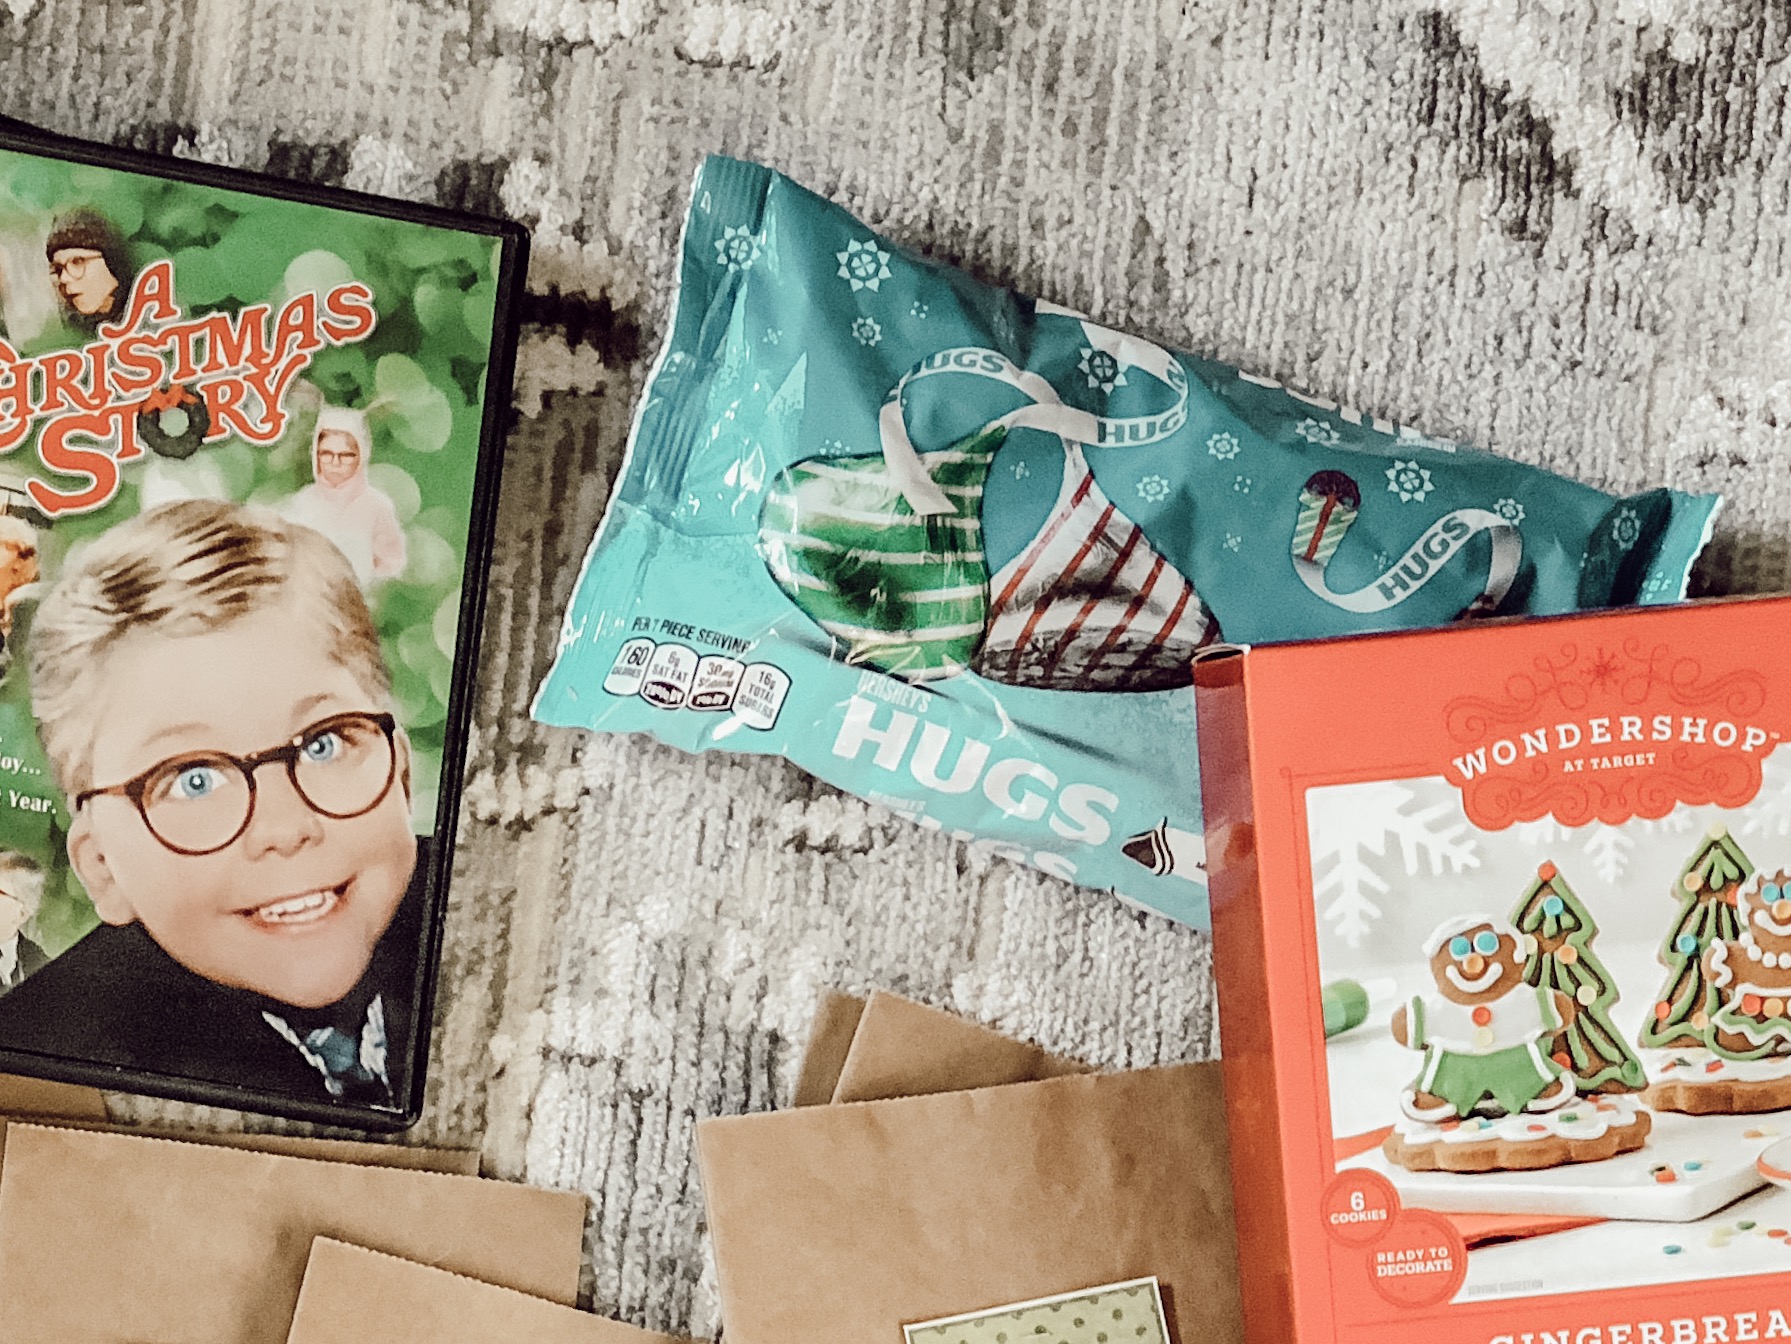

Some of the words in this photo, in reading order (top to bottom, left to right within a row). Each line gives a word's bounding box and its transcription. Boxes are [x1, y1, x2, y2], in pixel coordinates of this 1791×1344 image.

[101, 261, 178, 338] A
[1096, 402, 1189, 445] HUG
[25, 354, 312, 516] STORY
[1376, 516, 1471, 602] HUGS
[660, 619, 697, 641] PIECE
[619, 644, 651, 667] 160
[651, 663, 671, 679] SAT
[670, 669, 689, 684] FAT
[747, 682, 776, 704] TOTAL
[1452, 714, 1768, 780] WONDERSHOP
[832, 694, 1120, 846] HUGS
[1563, 758, 1584, 773] AT
[1591, 752, 1657, 772] TARGET
[8, 788, 58, 815] Year.
[1350, 1190, 1366, 1212] 6
[1330, 1209, 1388, 1226] COOKIES
[1376, 1248, 1425, 1264] READY
[1429, 1246, 1449, 1259] TO
[1376, 1257, 1453, 1278] DECORATE
